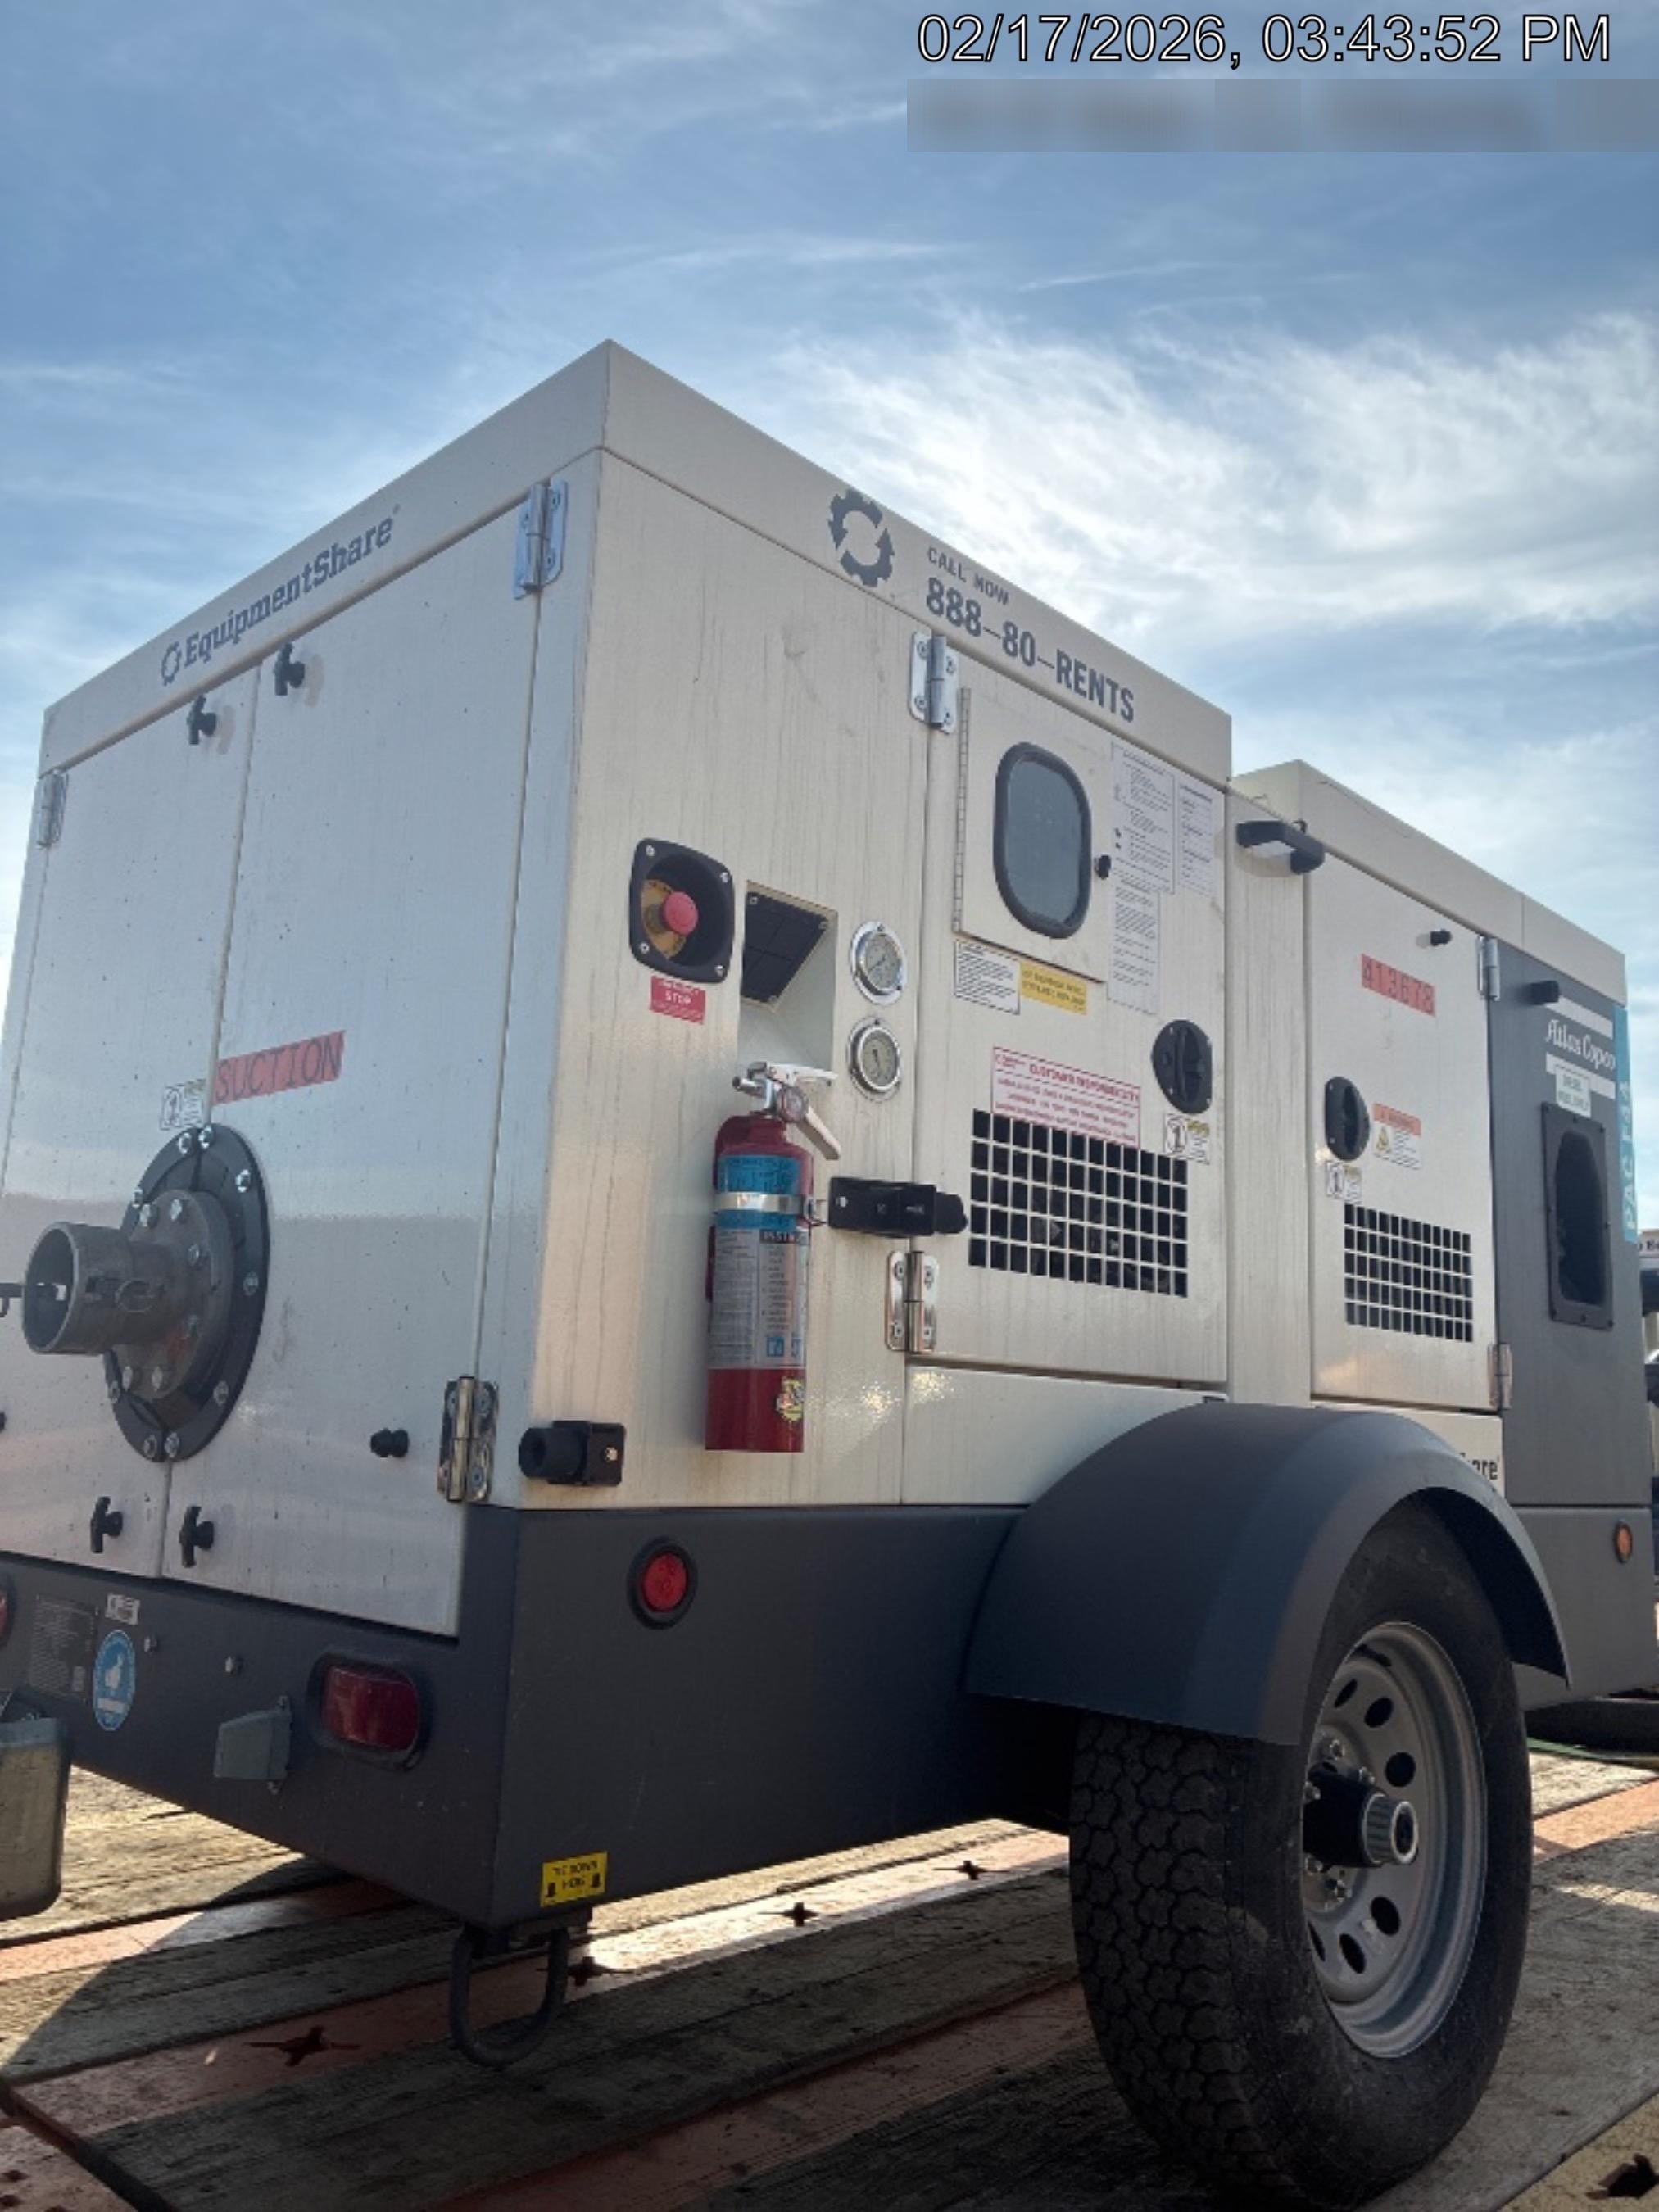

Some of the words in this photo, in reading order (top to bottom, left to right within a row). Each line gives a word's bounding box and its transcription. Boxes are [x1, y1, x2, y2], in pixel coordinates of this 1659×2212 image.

[184, 517, 393, 668] EquipmentShare
[928, 547, 967, 582] CALL
[974, 574, 1009, 605] NOW
[665, 990, 692, 1006] STOP
[215, 1031, 345, 1104] SUCTION
[1545, 1019, 1581, 1055] Atlas
[1583, 1034, 1616, 1070] Copco
